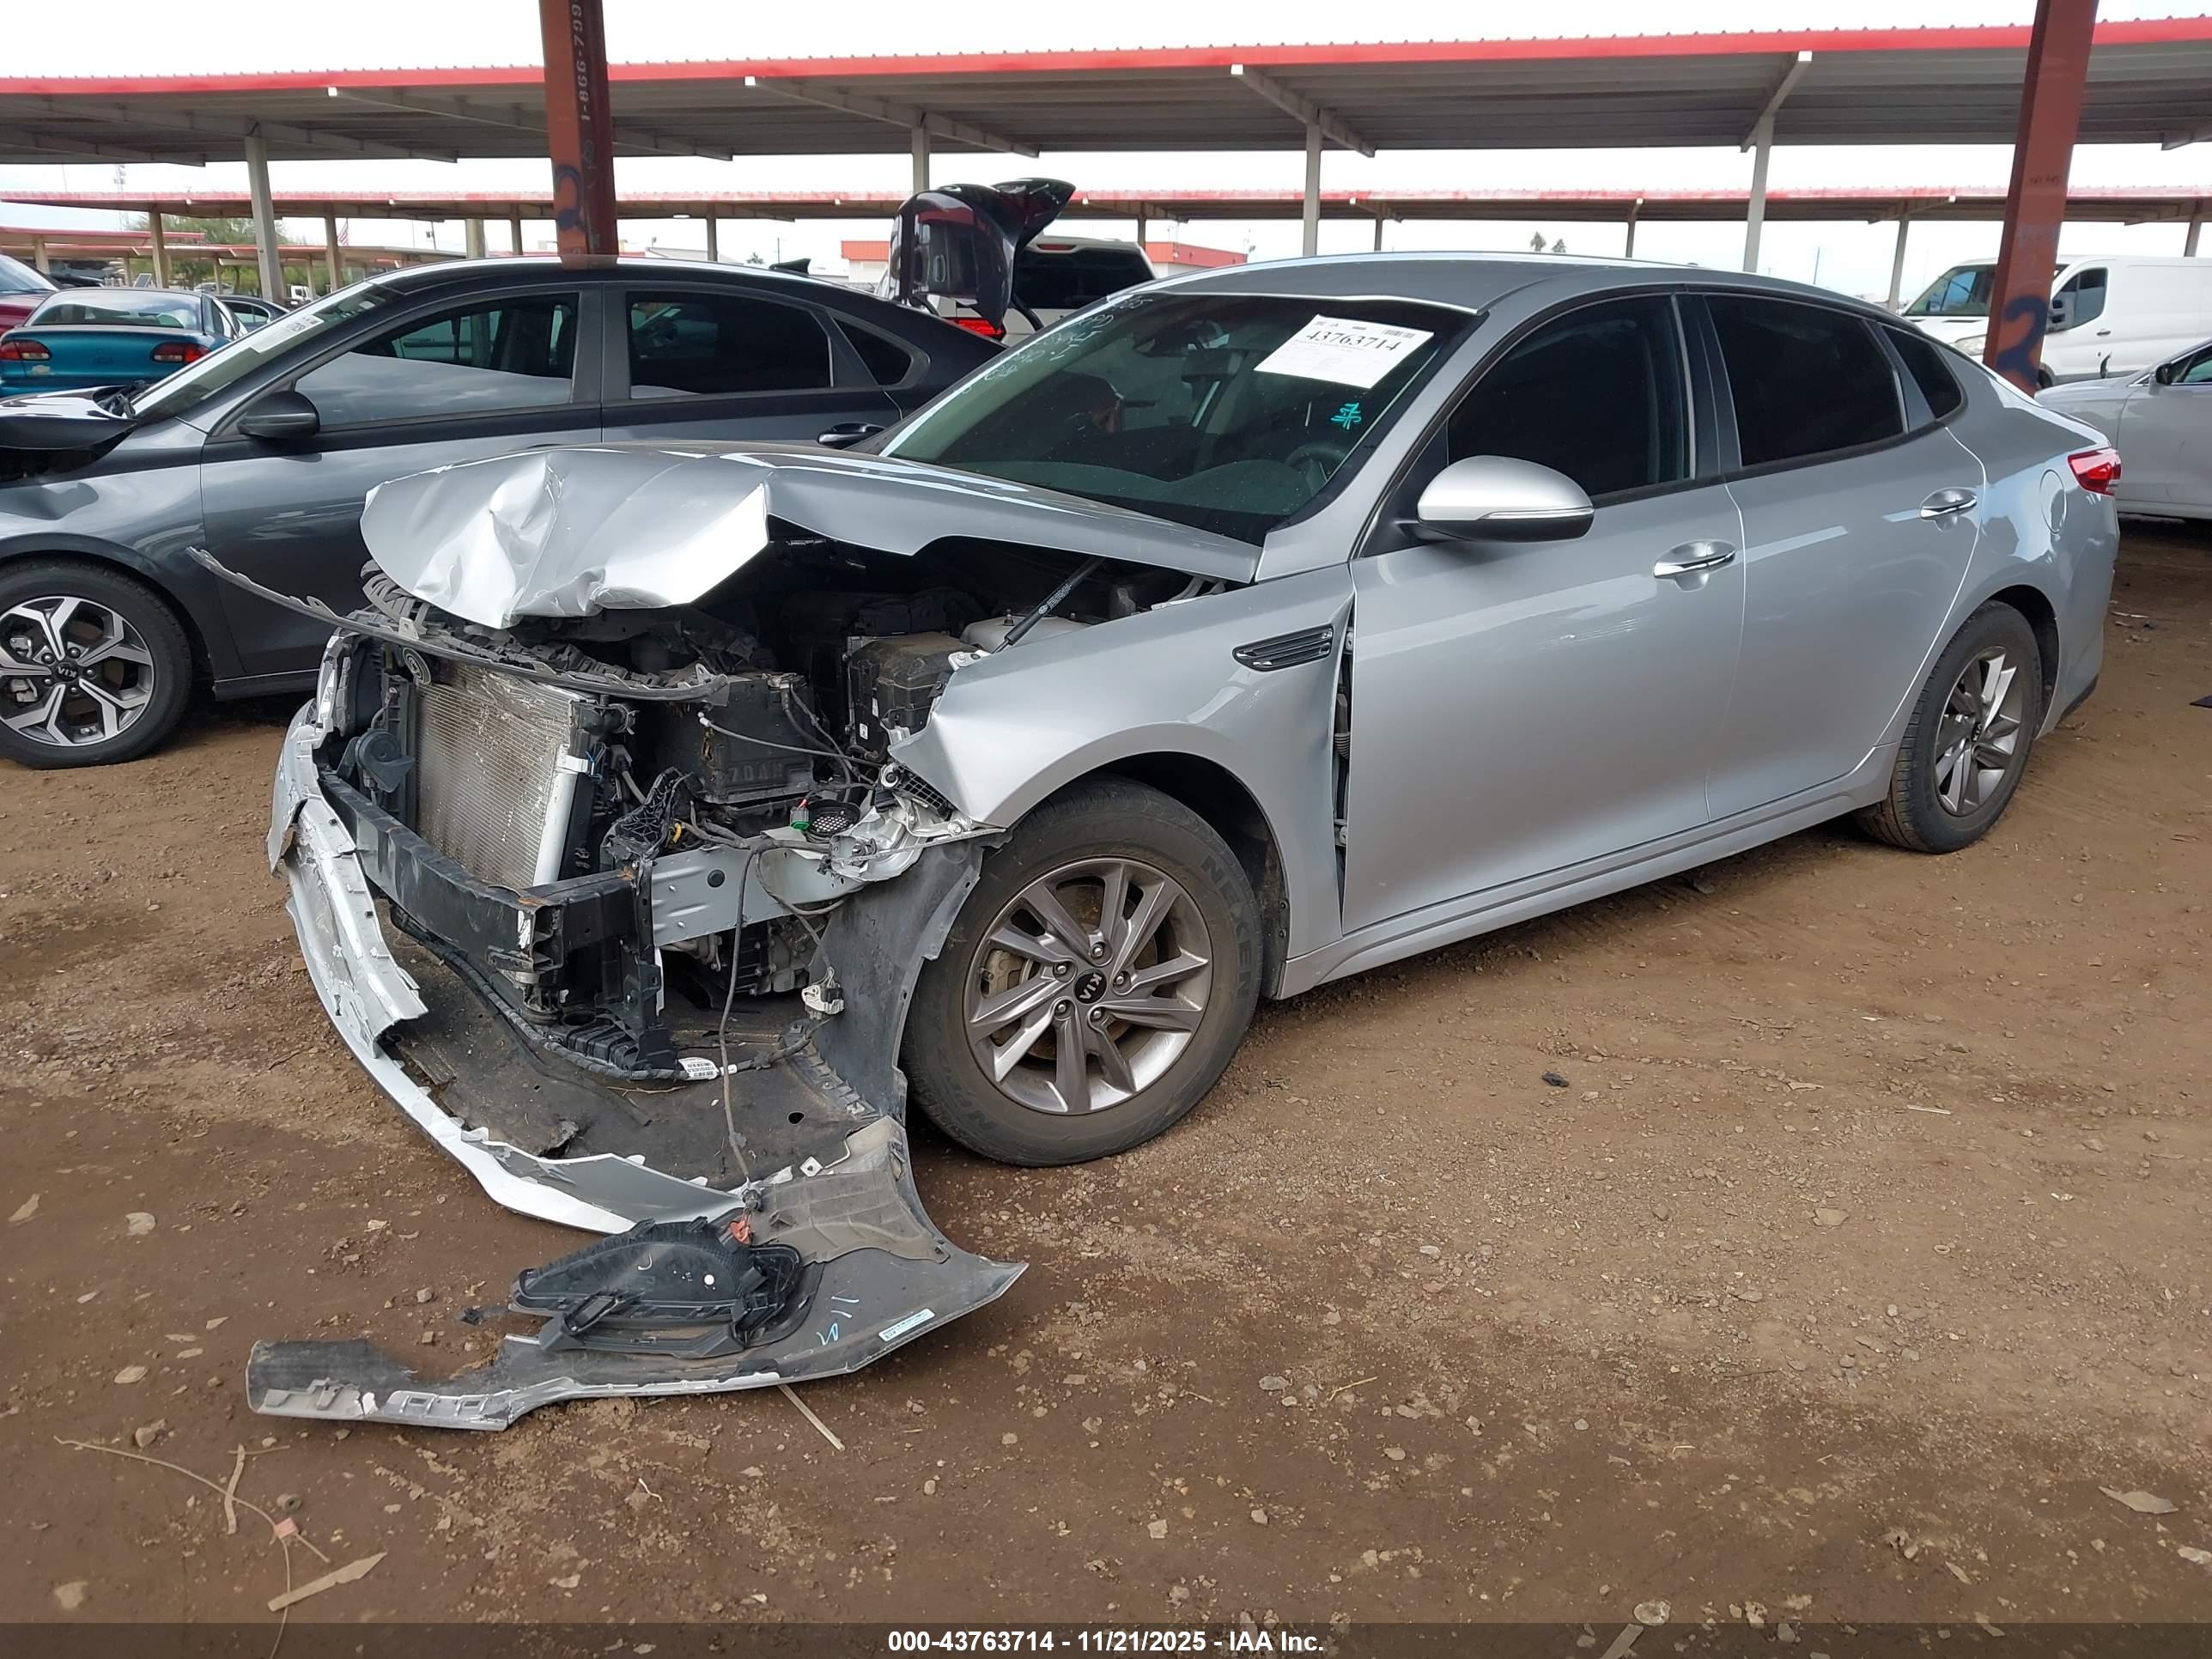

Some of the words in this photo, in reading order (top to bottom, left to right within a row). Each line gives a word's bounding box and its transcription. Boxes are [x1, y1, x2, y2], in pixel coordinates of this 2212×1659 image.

[570, 0, 592, 121] 1-866-799
[1306, 331, 1401, 351] 43763714
[1996, 295, 2049, 386] 2
[1079, 972, 1103, 1000] KIA
